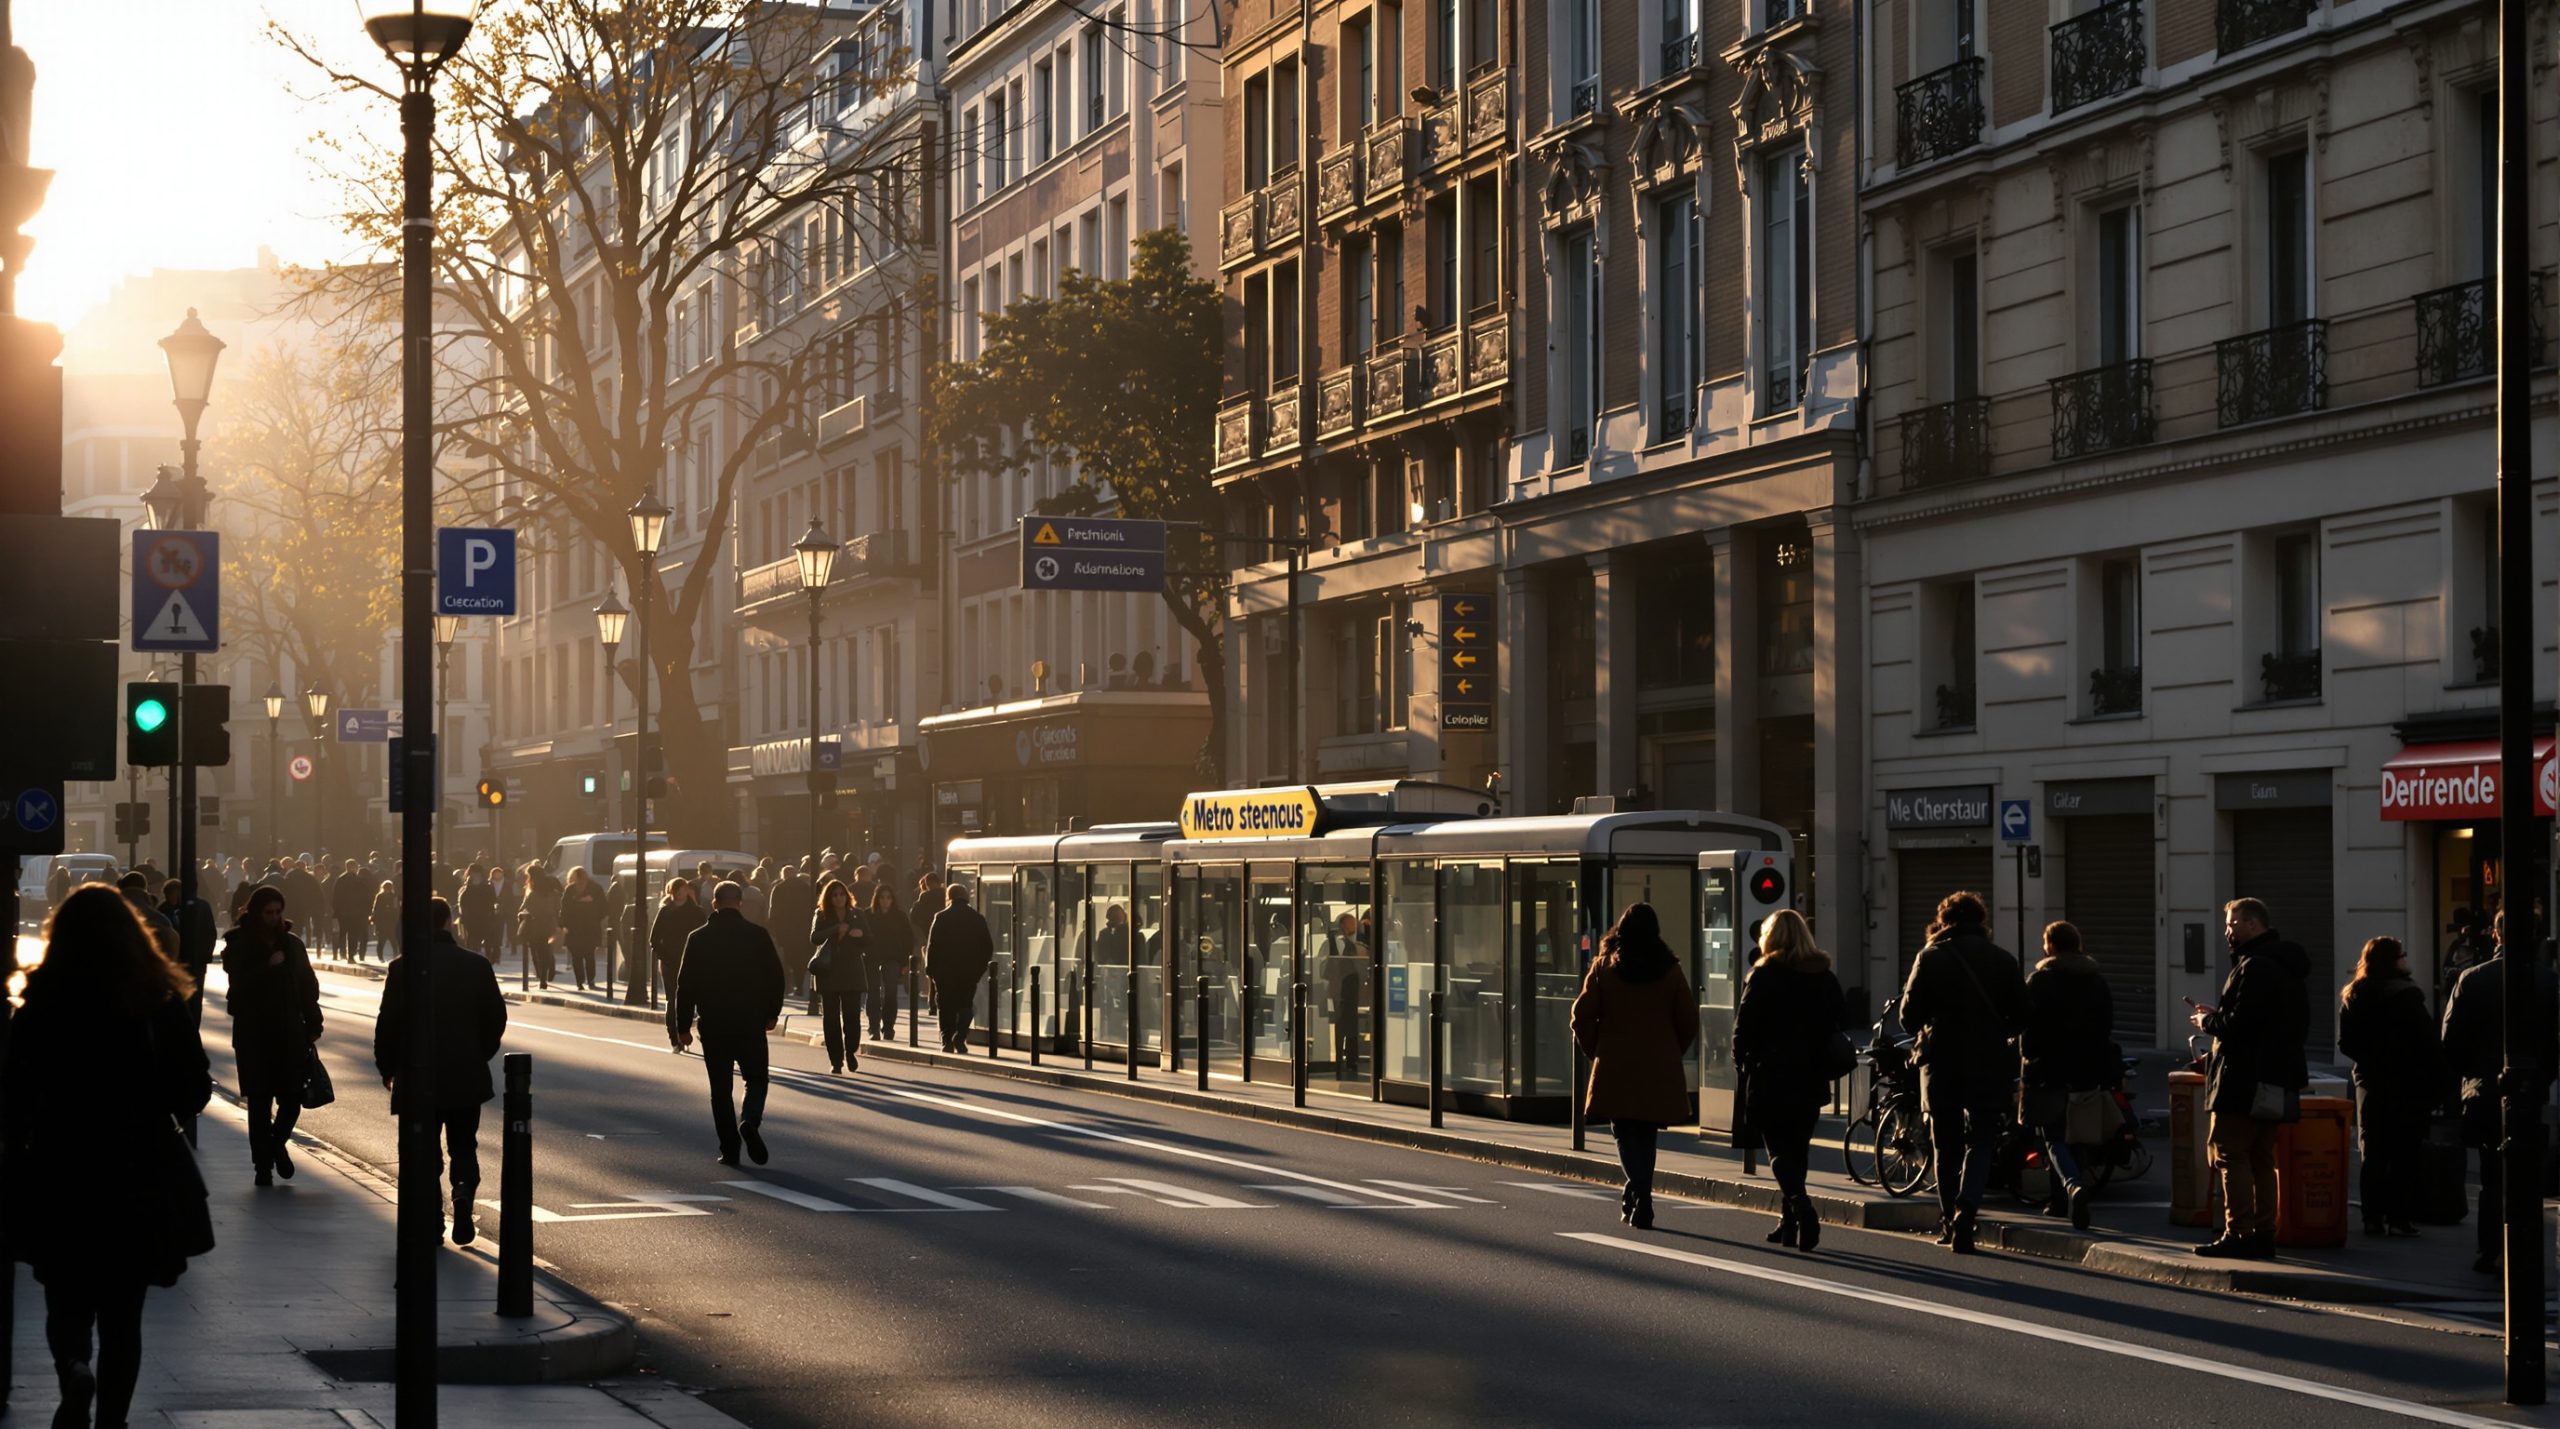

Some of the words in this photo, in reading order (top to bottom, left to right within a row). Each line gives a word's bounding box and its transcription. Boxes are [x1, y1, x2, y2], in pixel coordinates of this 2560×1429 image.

[465, 538, 497, 587] P
[1193, 798, 1234, 832] Metro
[1914, 796, 1988, 821] Cherstaur
